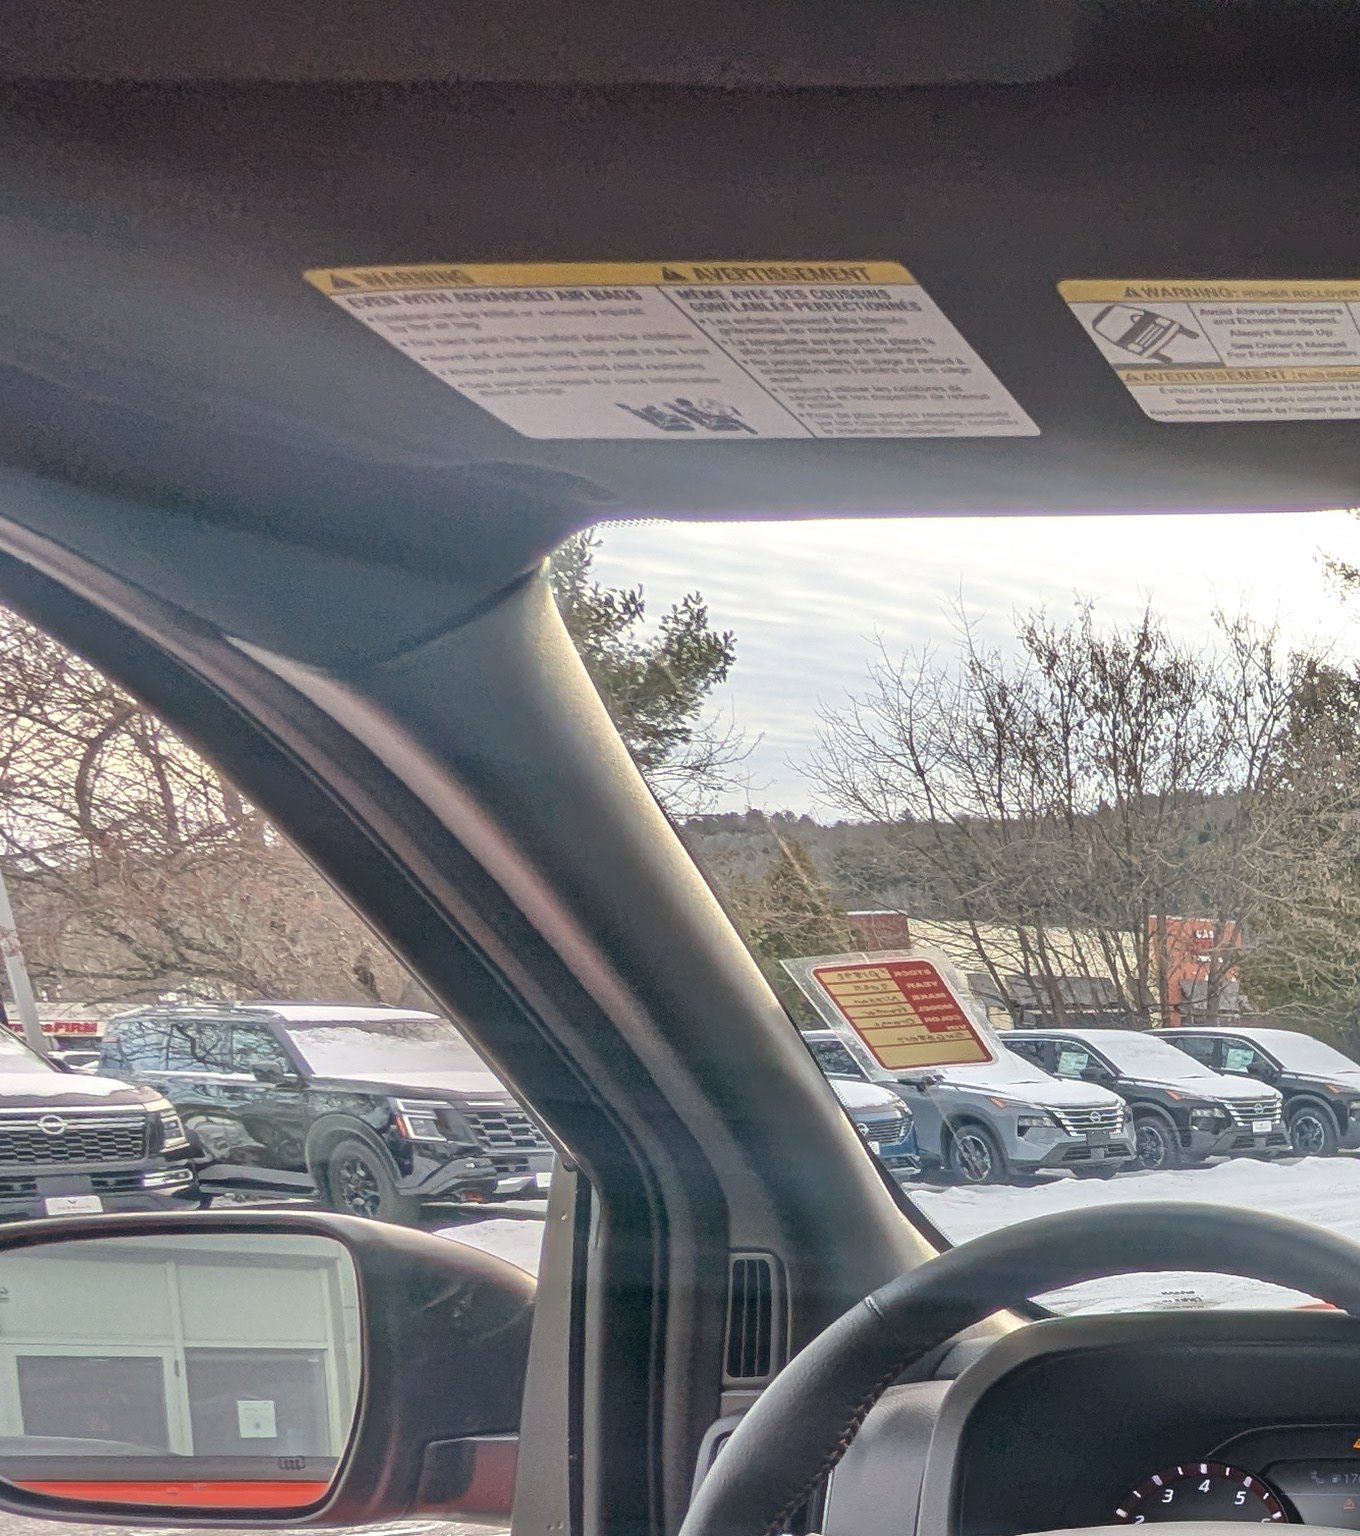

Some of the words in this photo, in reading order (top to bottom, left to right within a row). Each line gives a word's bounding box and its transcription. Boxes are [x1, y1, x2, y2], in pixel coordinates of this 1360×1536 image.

[692, 266, 871, 281] AVERTISSEMENT
[1199, 1479, 1210, 1493] 4
[1162, 1488, 1174, 1503] 3
[1234, 1491, 1247, 1505] 5
